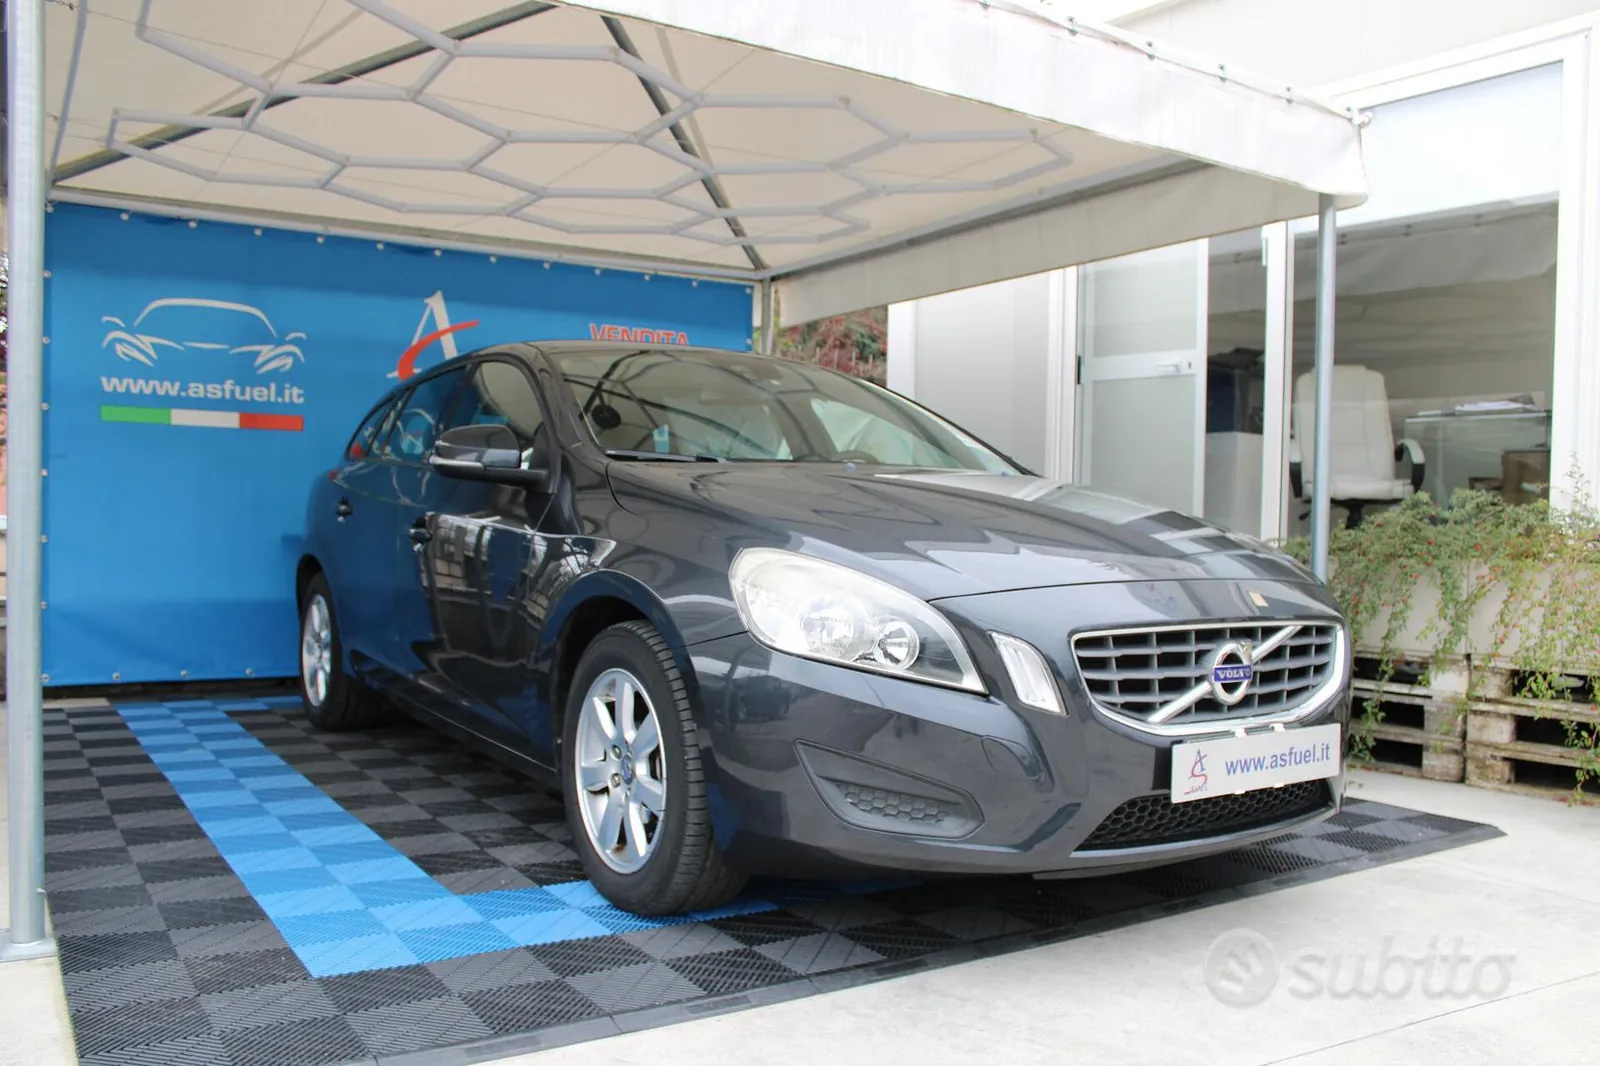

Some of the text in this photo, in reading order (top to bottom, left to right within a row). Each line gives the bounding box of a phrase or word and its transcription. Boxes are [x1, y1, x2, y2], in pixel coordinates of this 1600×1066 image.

[589, 323, 689, 345] VENDITA
[100, 376, 305, 404] www.asfuel.it
[1216, 667, 1250, 679] VOLVO
[1225, 743, 1331, 776] www.asfuel.it
